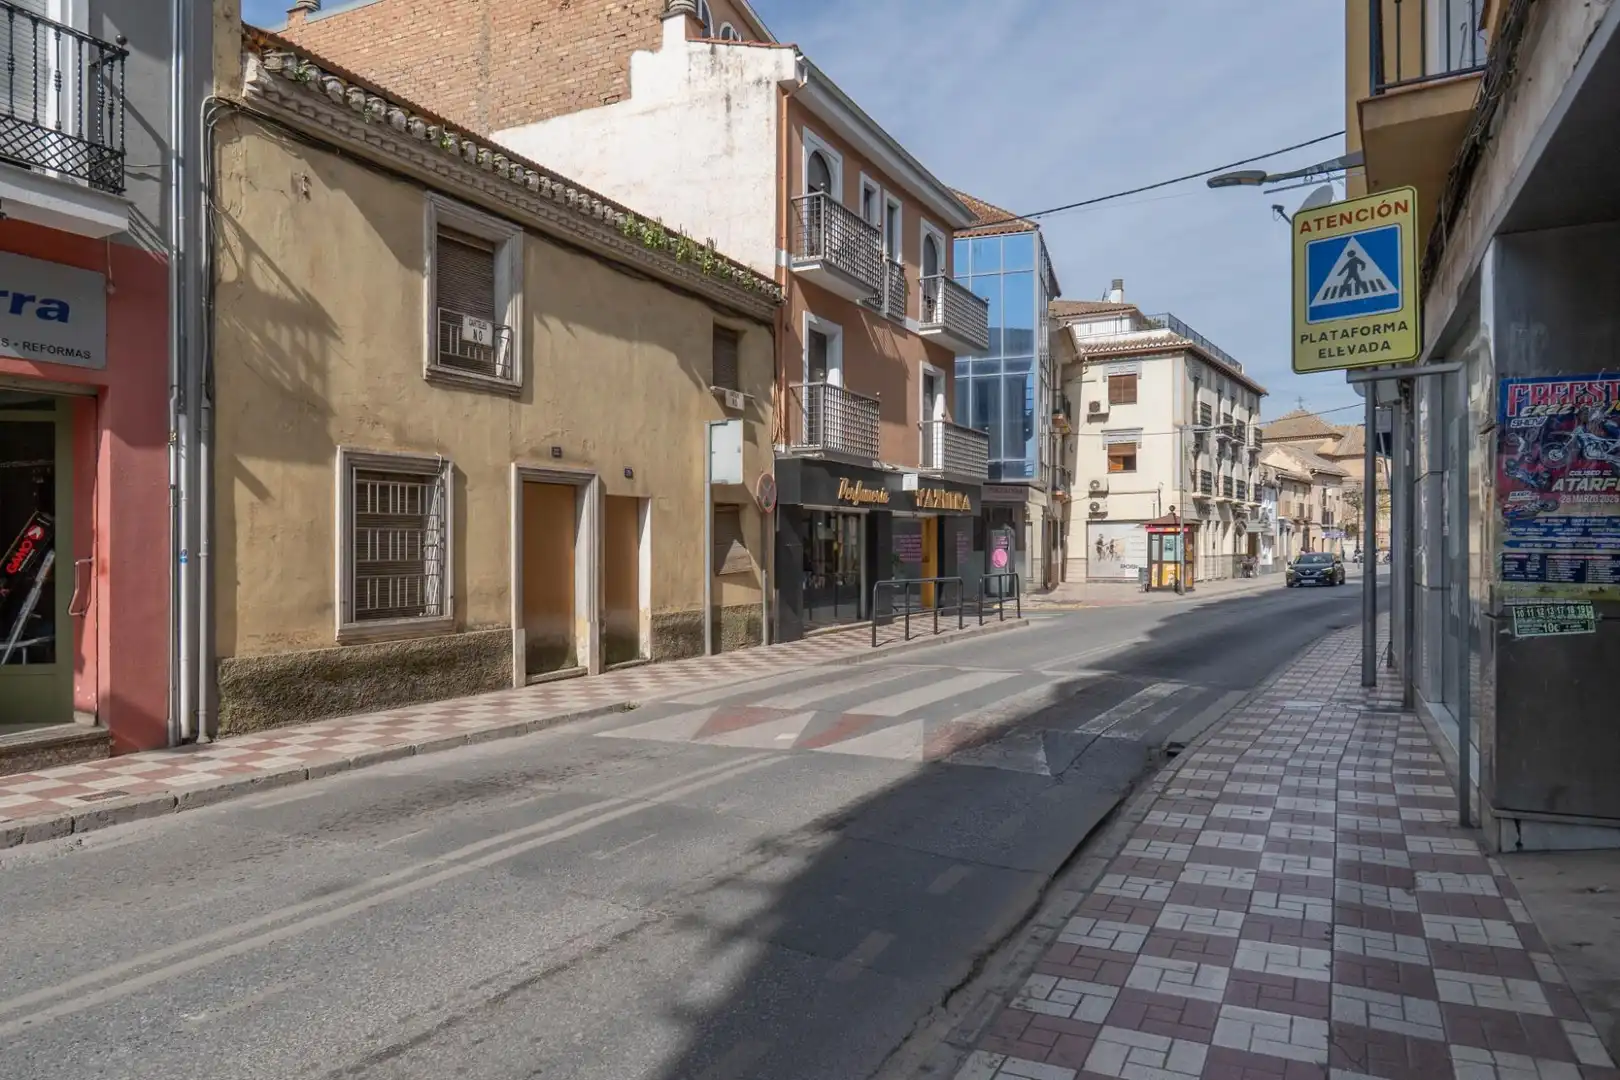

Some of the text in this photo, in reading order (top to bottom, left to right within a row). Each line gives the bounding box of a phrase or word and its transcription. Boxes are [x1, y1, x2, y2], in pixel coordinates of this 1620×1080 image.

[1300, 199, 1409, 234] ATENCIÓN
[0, 290, 70, 324] ra
[473, 329, 483, 341] NO
[1300, 320, 1409, 345] PLATAFORMA
[22, 341, 92, 360] REFORMAS
[1318, 340, 1392, 359] ELEVADA
[1536, 607, 1545, 616] 12
[1546, 606, 1555, 615] 13
[1556, 605, 1564, 614] 17
